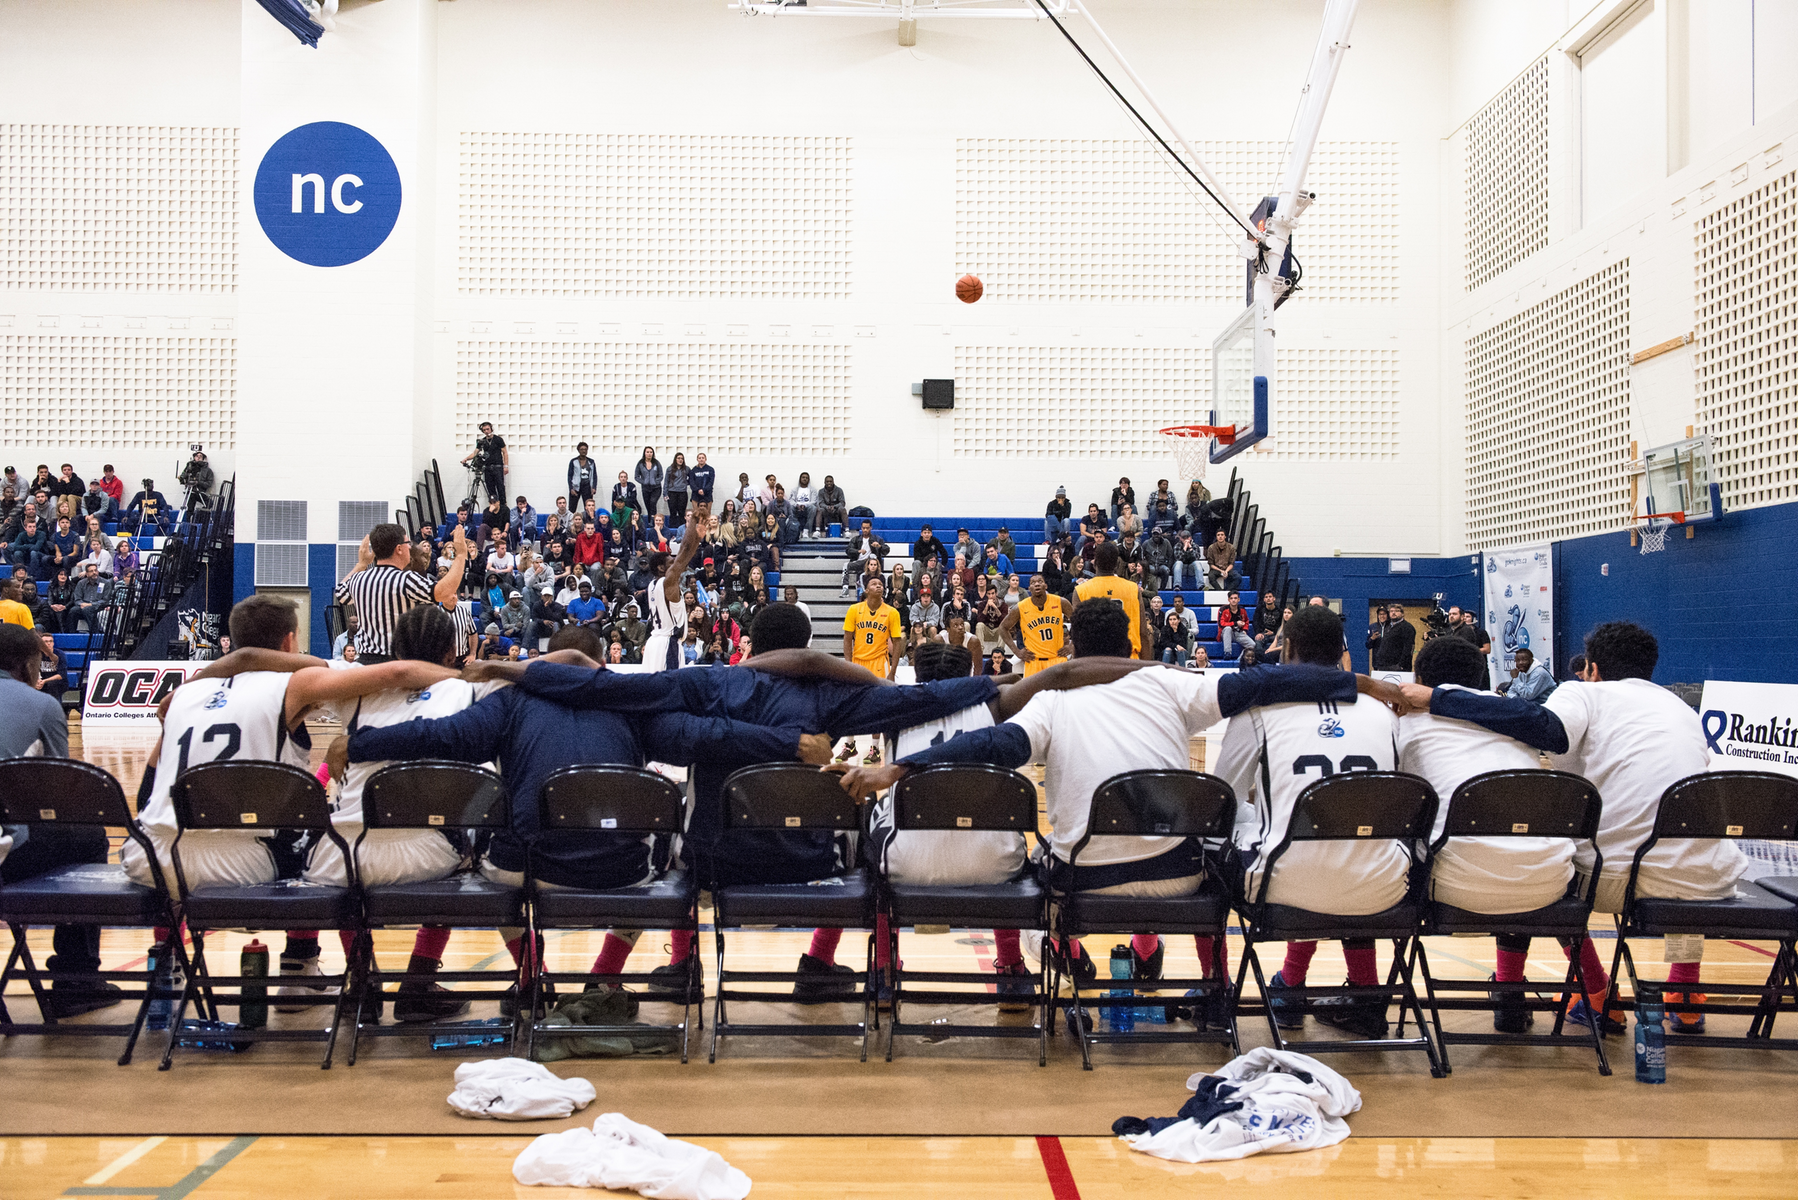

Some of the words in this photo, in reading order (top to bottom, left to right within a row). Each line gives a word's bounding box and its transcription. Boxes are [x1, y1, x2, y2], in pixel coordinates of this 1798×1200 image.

[291, 173, 364, 214] nc
[1027, 616, 1060, 630] HUMBER
[866, 632, 874, 644] 8
[1039, 628, 1053, 641] 10
[88, 669, 193, 707] OCA
[1726, 744, 1780, 762] Construction
